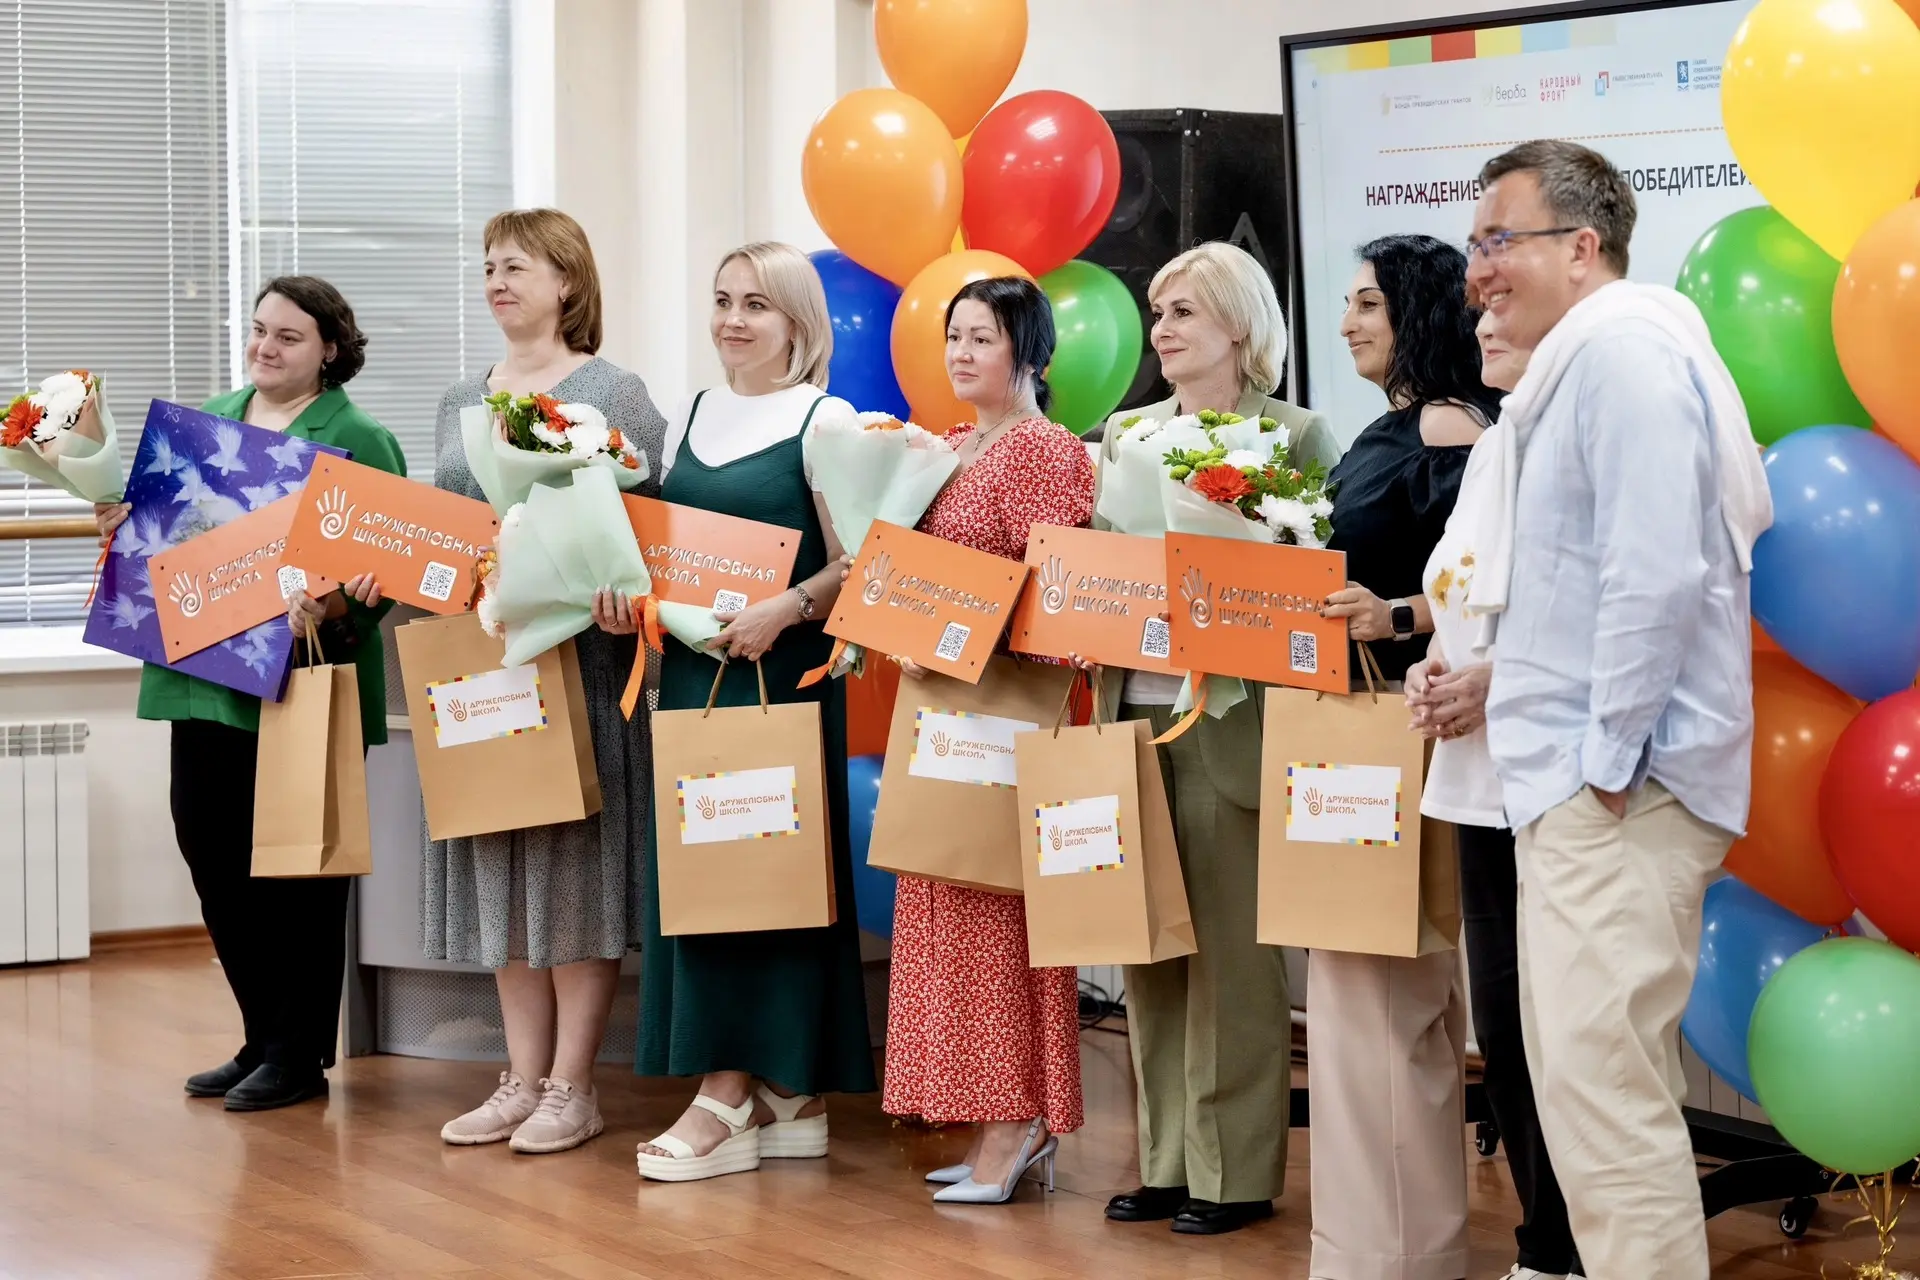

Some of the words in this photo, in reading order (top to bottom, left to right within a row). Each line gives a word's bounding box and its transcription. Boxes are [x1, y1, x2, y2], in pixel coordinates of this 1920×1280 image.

[1540, 74, 1581, 89] НАРОДНЫЙ
[1495, 84, 1527, 102] верба
[1540, 90, 1566, 102] ФРОНТ
[1366, 179, 1480, 209] НАГРАЖДЕНИЕ
[352, 526, 412, 558] ШКОЛА
[206, 536, 288, 585] ДРУЖЕЛЮБ
[644, 543, 776, 583] ДРУЖЕЛЮБНАЯ
[207, 570, 262, 602] ШКОЛА
[896, 574, 1000, 616] ДРУЖЕЛЮБНАЯ
[1076, 575, 1167, 601] ДРУЖЕЛЮБ
[887, 590, 936, 618] ШКОЛА
[1072, 595, 1129, 616] ШКОЛА
[1218, 586, 1323, 613] ДРУЖЕЛЮБНА
[1218, 607, 1274, 630] ШКОЛА
[469, 691, 532, 709] ДРУЖЕЛЮБНАЯ
[470, 706, 501, 717] ШКОЛА
[952, 749, 986, 760] ШКОЛА
[953, 740, 1016, 755] ДРУЖЕЛЮБН
[719, 794, 786, 807] ДРУЖЕЛЮБНАЯ
[1326, 796, 1389, 806] ДРУЖЕЛЮБНАЯ
[719, 807, 752, 816] ШКОЛА
[1325, 806, 1357, 815] ШКОЛА
[1064, 825, 1112, 837] ДРУЖЕЛЮБНАЯ
[1064, 838, 1088, 847] ШКОЛА
